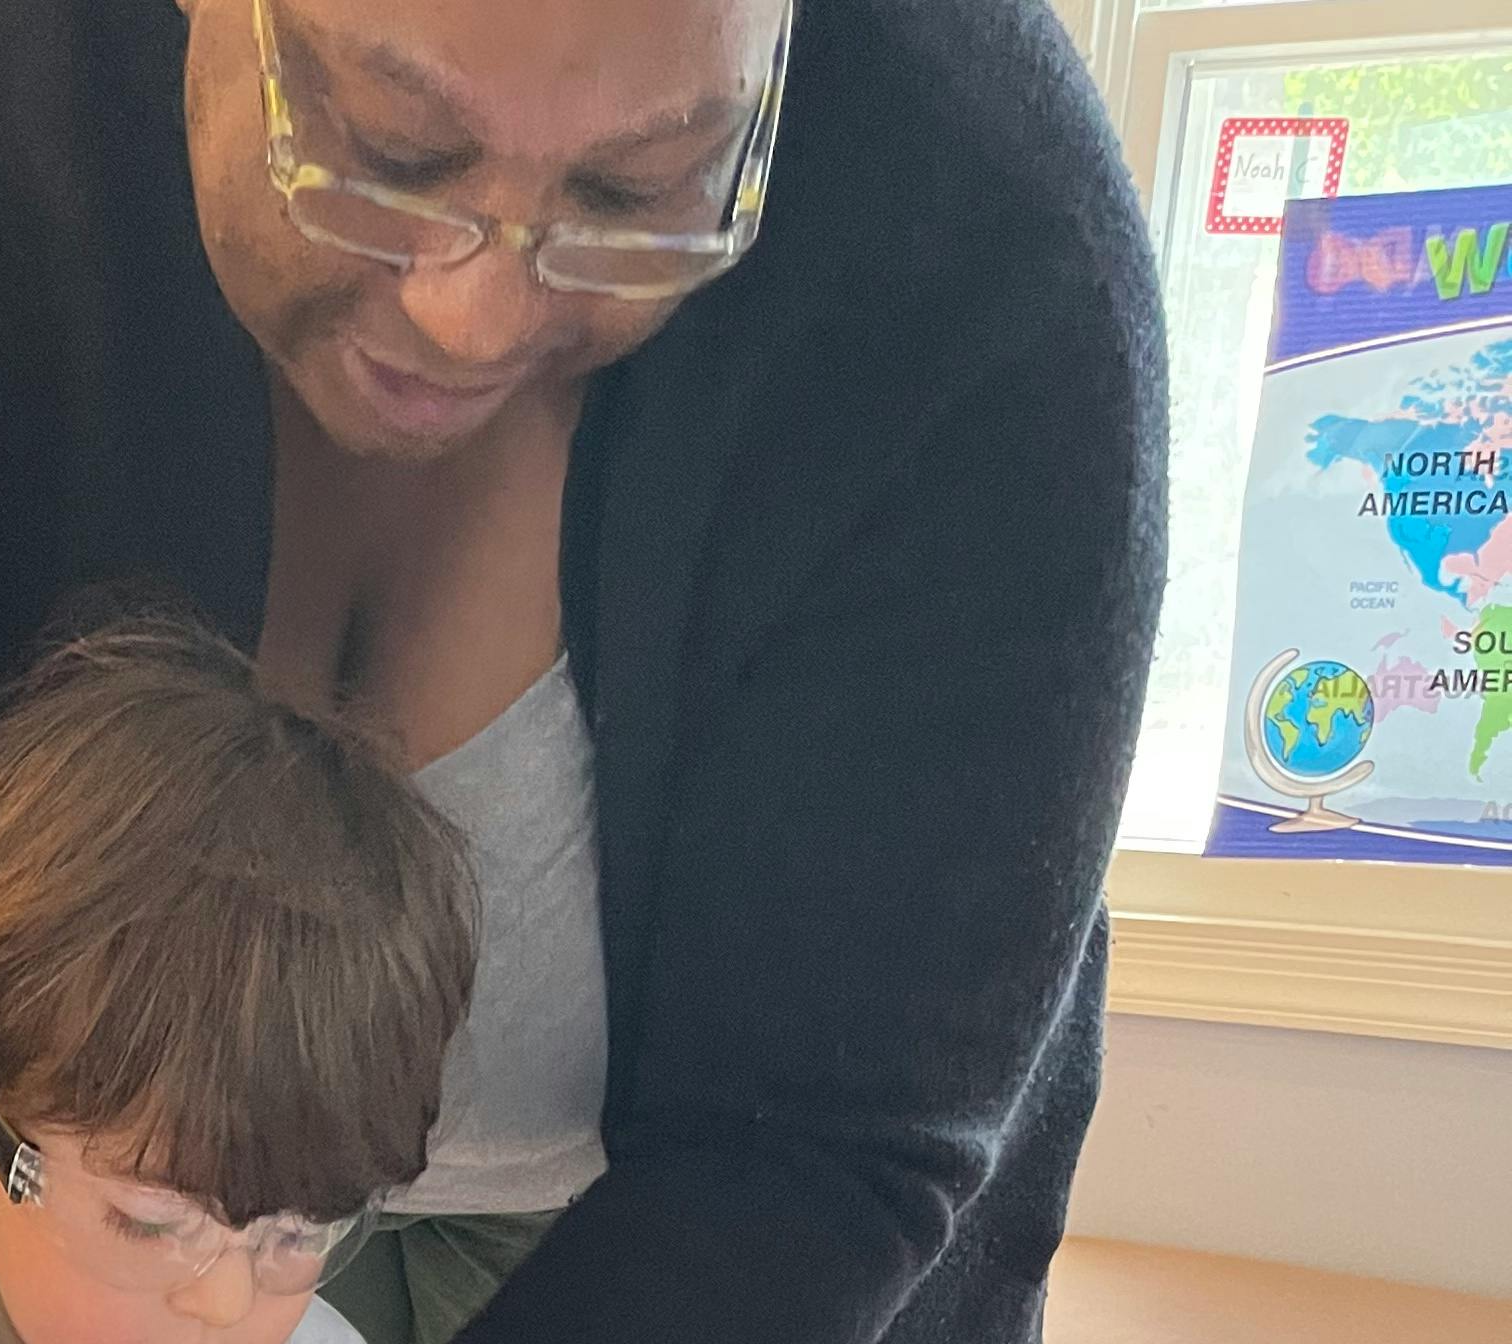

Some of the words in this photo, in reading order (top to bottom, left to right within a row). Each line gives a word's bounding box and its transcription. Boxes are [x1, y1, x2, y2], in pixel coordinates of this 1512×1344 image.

[1233, 152, 1285, 180] Noah
[1426, 222, 1512, 301] W
[1381, 450, 1497, 478] NORTH
[1357, 489, 1509, 517] AMERICA
[1349, 580, 1400, 593] PACIFIC
[1349, 596, 1396, 610] OCEAN
